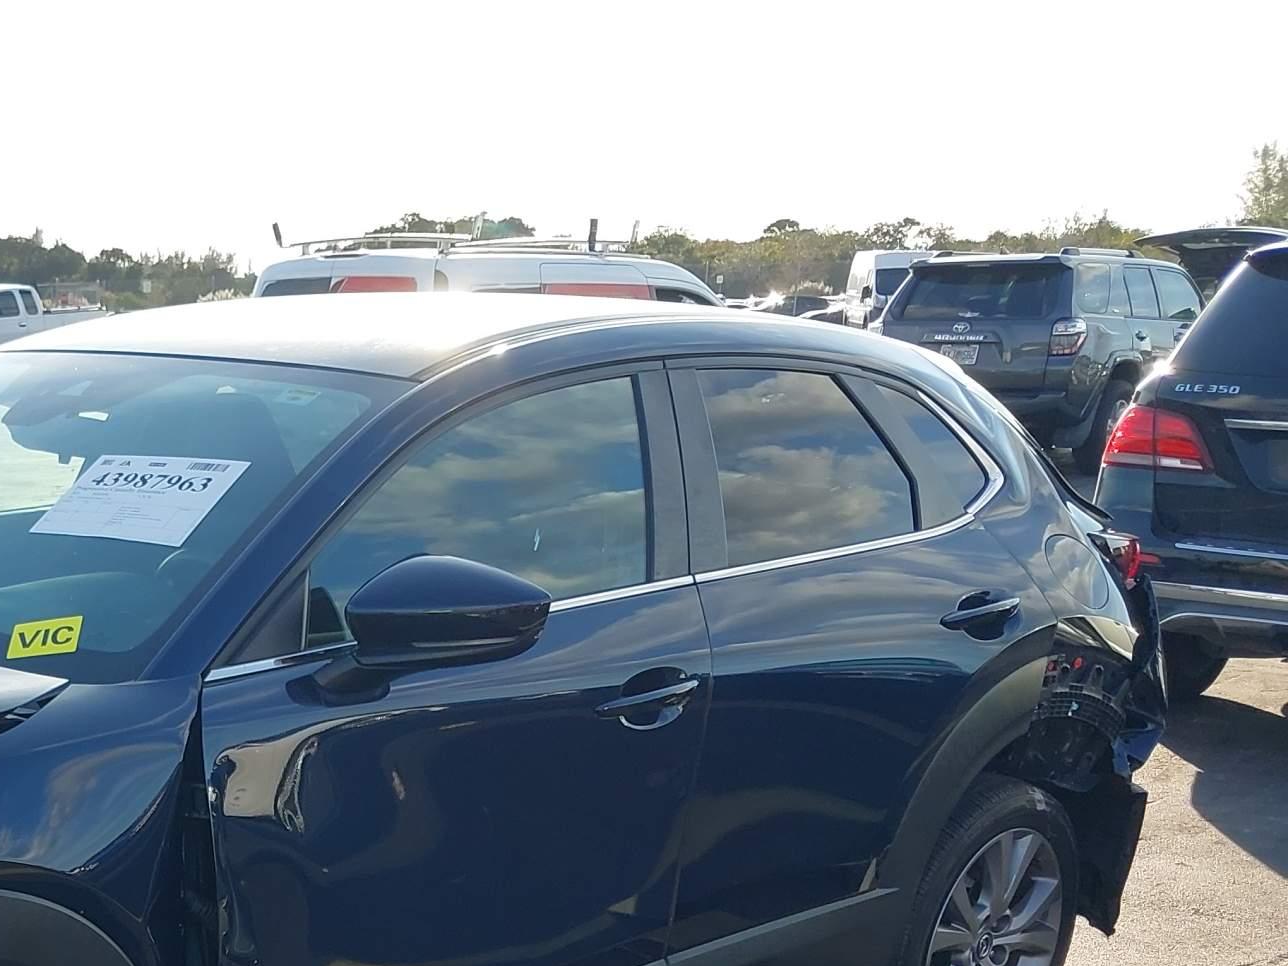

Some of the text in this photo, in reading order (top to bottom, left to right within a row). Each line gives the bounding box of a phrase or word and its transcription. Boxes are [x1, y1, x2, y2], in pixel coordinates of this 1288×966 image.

[1175, 383, 1241, 394] GLE 350
[91, 471, 214, 493] 43987963
[18, 626, 74, 649] VIC
